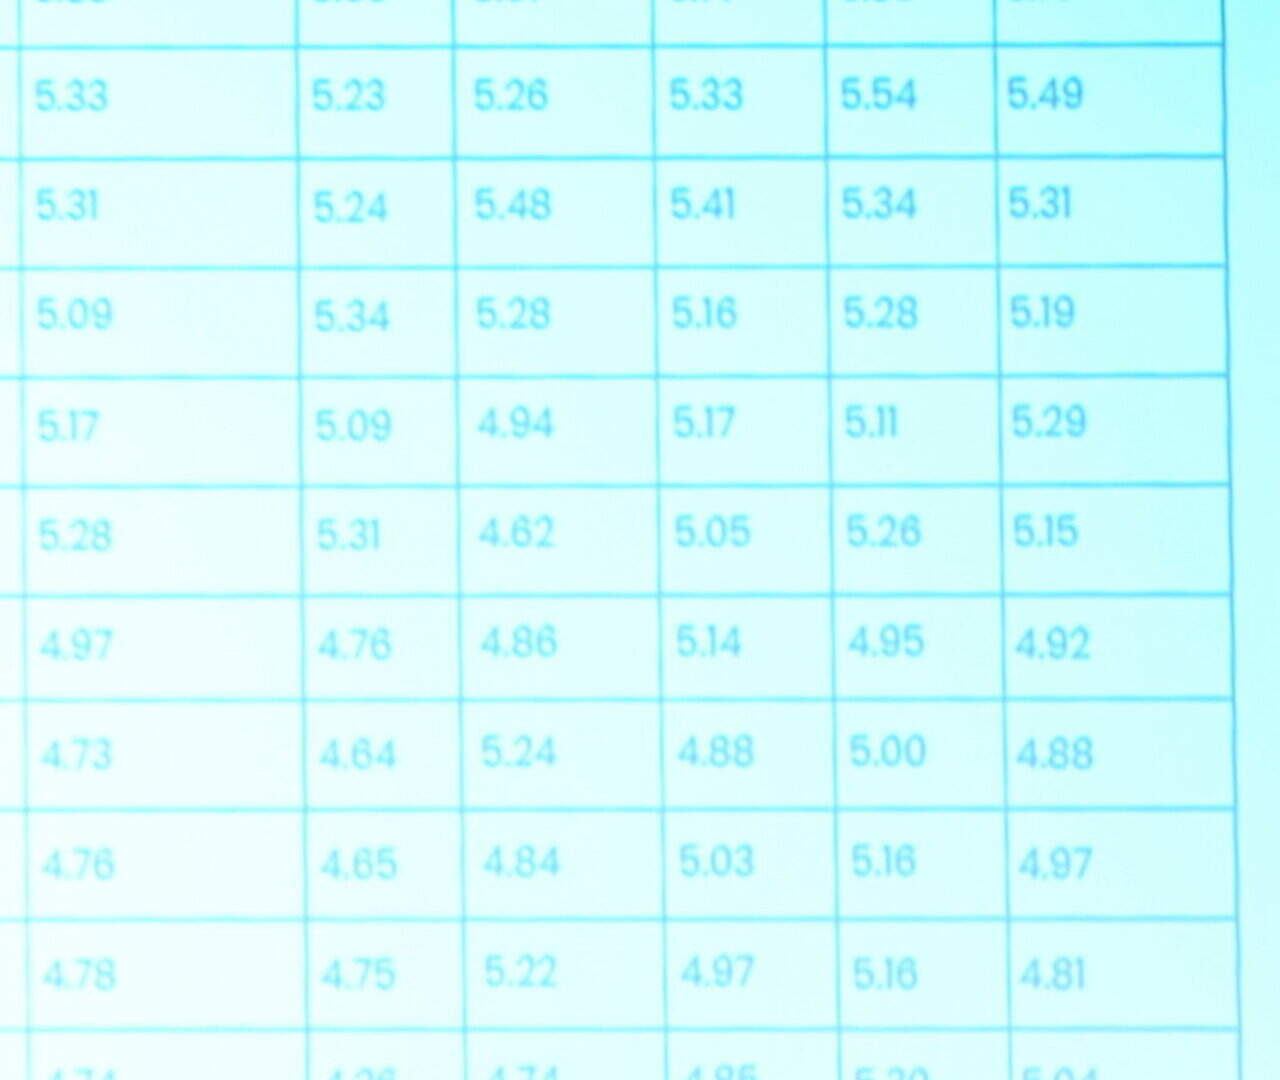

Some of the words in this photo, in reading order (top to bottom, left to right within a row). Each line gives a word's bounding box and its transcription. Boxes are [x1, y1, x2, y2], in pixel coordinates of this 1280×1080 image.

[35, 78, 108, 112] 5.33
[312, 77, 386, 112] 5.23
[474, 77, 549, 111] 5.26
[670, 76, 744, 111] 5.33
[842, 76, 917, 110] 5.54
[1008, 75, 1084, 110] 5.49
[36, 187, 98, 221] 5.31
[314, 189, 388, 224] 5.24
[475, 187, 552, 220] 5.48
[671, 186, 736, 220] 5.41
[842, 186, 918, 220] 5.34
[1008, 184, 1072, 219] 5.31
[37, 296, 113, 330] 5.09
[314, 299, 390, 332] 5.34
[476, 296, 552, 330] 5.28
[672, 295, 738, 328] 5.16
[844, 294, 919, 330] 5.28
[1010, 293, 1076, 328] 5.19
[37, 408, 101, 443] 5.17
[315, 408, 392, 442] 5.09
[477, 405, 555, 439] 4.94
[672, 404, 736, 438] 5.17
[845, 404, 898, 438] 5.11
[1012, 403, 1088, 438] 5.29
[320, 956, 396, 991] 4.75
[485, 953, 557, 988] 5.22
[681, 953, 756, 988] 4.97
[853, 956, 919, 991] 5.16
